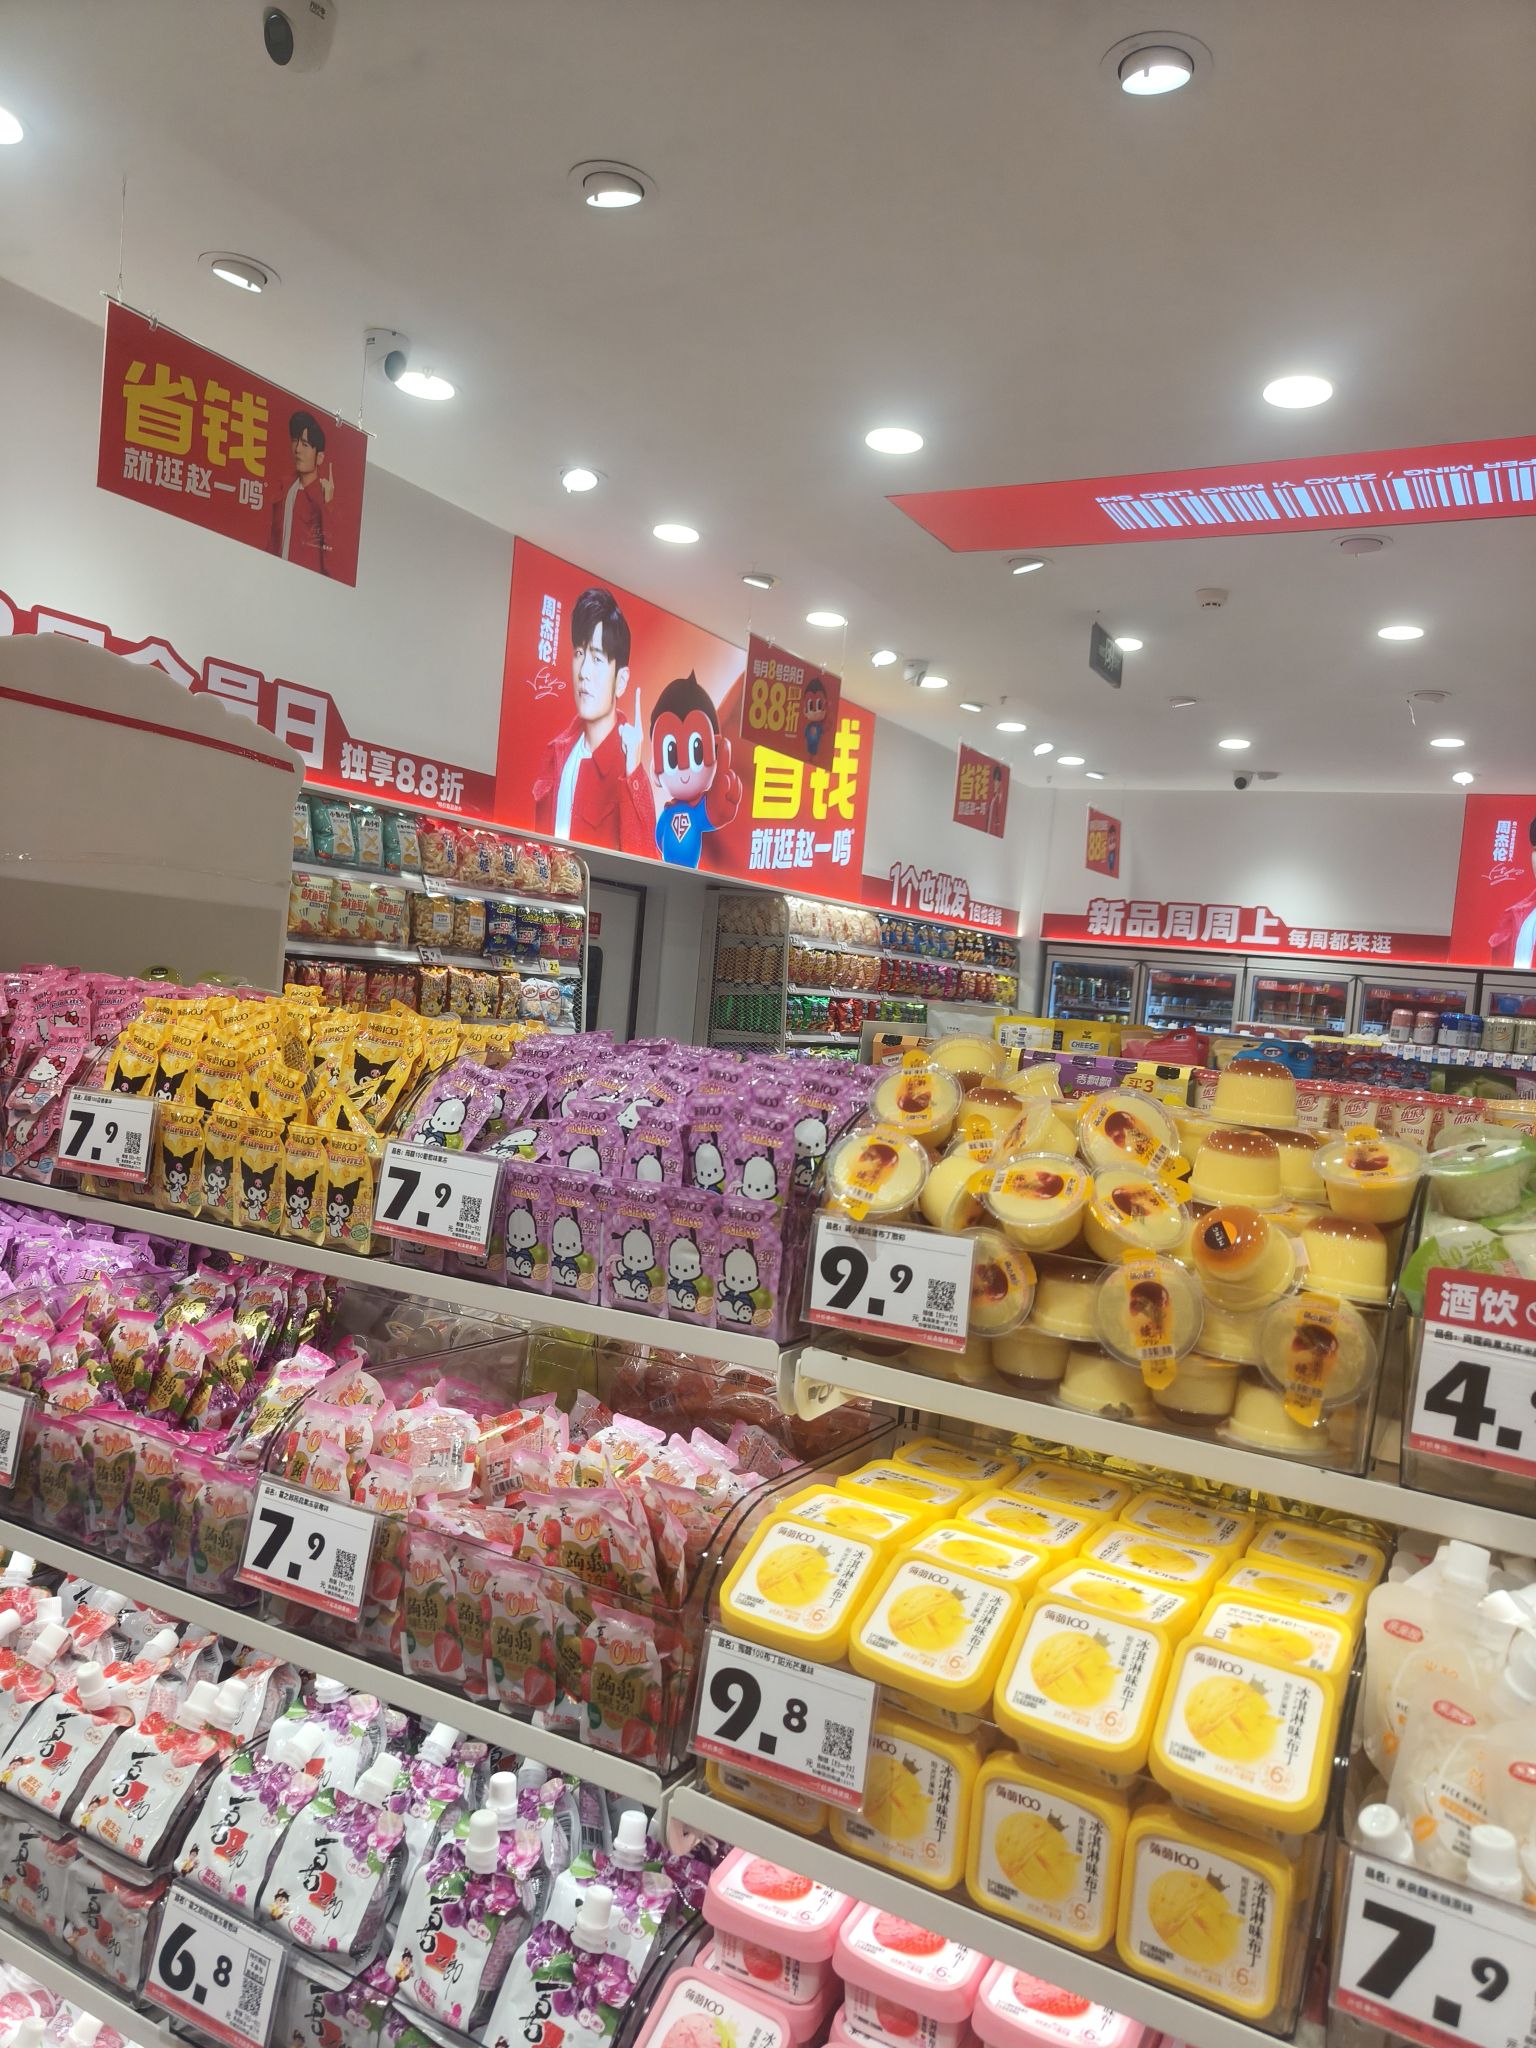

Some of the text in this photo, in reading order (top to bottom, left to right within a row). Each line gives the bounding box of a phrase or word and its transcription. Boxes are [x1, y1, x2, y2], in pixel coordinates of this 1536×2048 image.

[123, 360, 269, 477] 省钱
[123, 447, 264, 510] 就逛赵一鸣
[1140, 489, 1193, 499] LING
[1200, 483, 1264, 494] MING
[1304, 473, 1377, 485] ZHAO
[1403, 464, 1473, 476] MING
[1096, 494, 1134, 503] SHI
[340, 742, 464, 804] 独享8.8折
[960, 764, 990, 800] 省钱
[749, 828, 852, 869] 就逛赵一鸣
[1493, 820, 1511, 861] 周杰伦
[891, 863, 968, 919] 1个也批发
[1087, 900, 1280, 945] 新品周周上
[1288, 928, 1392, 954] 每周都来逛
[1071, 1041, 1100, 1051] CHEESE
[1076, 1073, 1112, 1087] 香飘飘
[65, 1110, 118, 1160] 7.9
[383, 1166, 452, 1227] 7.9
[820, 1246, 913, 1316] 9.9
[1440, 1281, 1519, 1328] 酒饮
[1424, 1360, 1536, 1450] 4.
[251, 1508, 325, 1581] 7.9
[777, 1525, 816, 1544] 蒟蒻100
[828, 1547, 867, 1609] 冰淇淋味布丁
[908, 1565, 949, 1586] 蒟蒻100
[966, 1592, 1004, 1657] 冰淇淋味布丁
[1044, 1608, 1089, 1631] 蒟蒻100
[1121, 1639, 1151, 1711] 冰淇淋味布丁
[1193, 1652, 1244, 1677] 蒟蒻100
[709, 1668, 808, 1755] 9.8
[1286, 1685, 1312, 1766] 冰淇淋味布丁
[936, 1764, 955, 1845] 冰淇淋味布丁
[1085, 1820, 1104, 1903] 冰淇淋味布丁
[1248, 1880, 1269, 1968] 冰淇淋味布丁
[158, 1922, 232, 2005] 6.8
[1356, 1898, 1509, 2028] 7.9
[685, 1988, 725, 2017] 蒟蒻100
